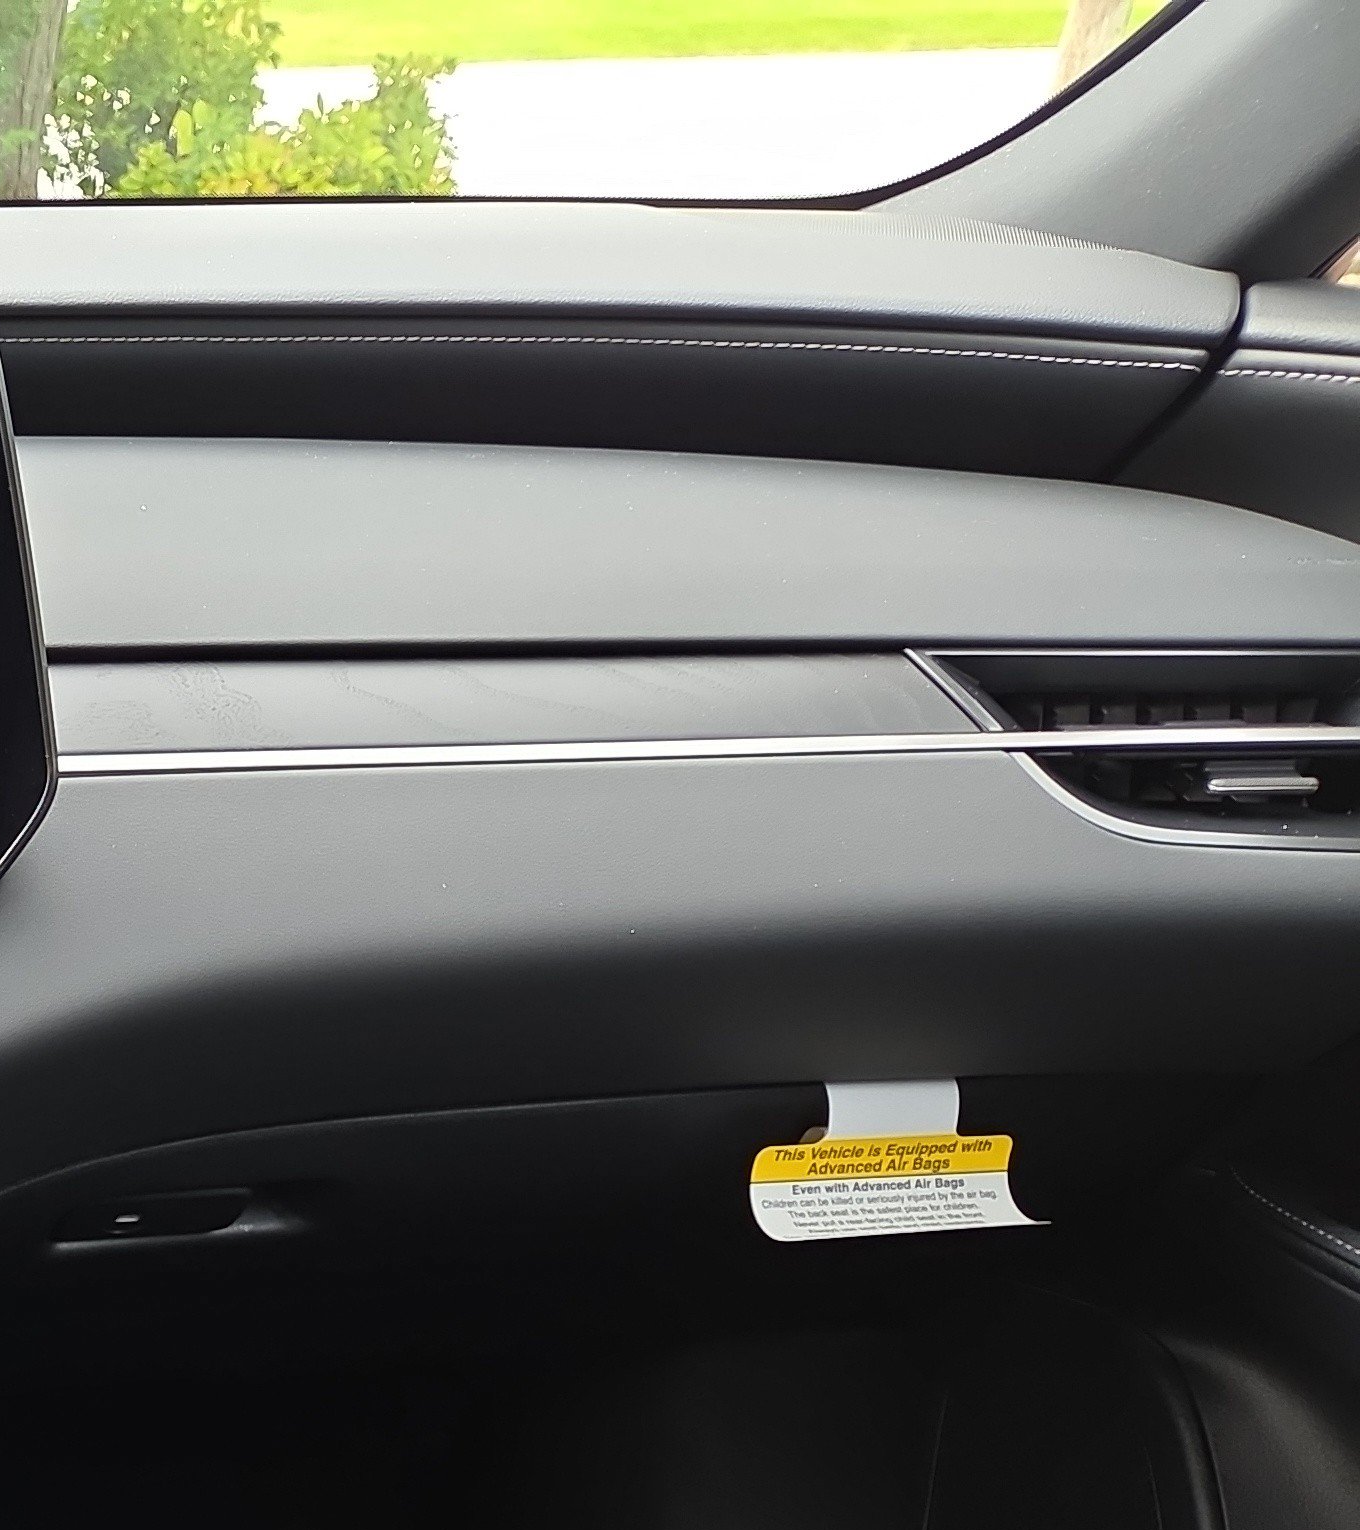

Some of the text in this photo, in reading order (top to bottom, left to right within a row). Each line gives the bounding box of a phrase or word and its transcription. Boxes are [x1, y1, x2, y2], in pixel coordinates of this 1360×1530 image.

[775, 1148, 805, 1161] This
[811, 1147, 864, 1160] Vehicle
[886, 1141, 958, 1159] Equipped
[962, 1140, 992, 1153] with
[807, 1158, 950, 1175] Advanced Air Bags
[792, 1178, 964, 1195] Even with Advanced Air Bags
